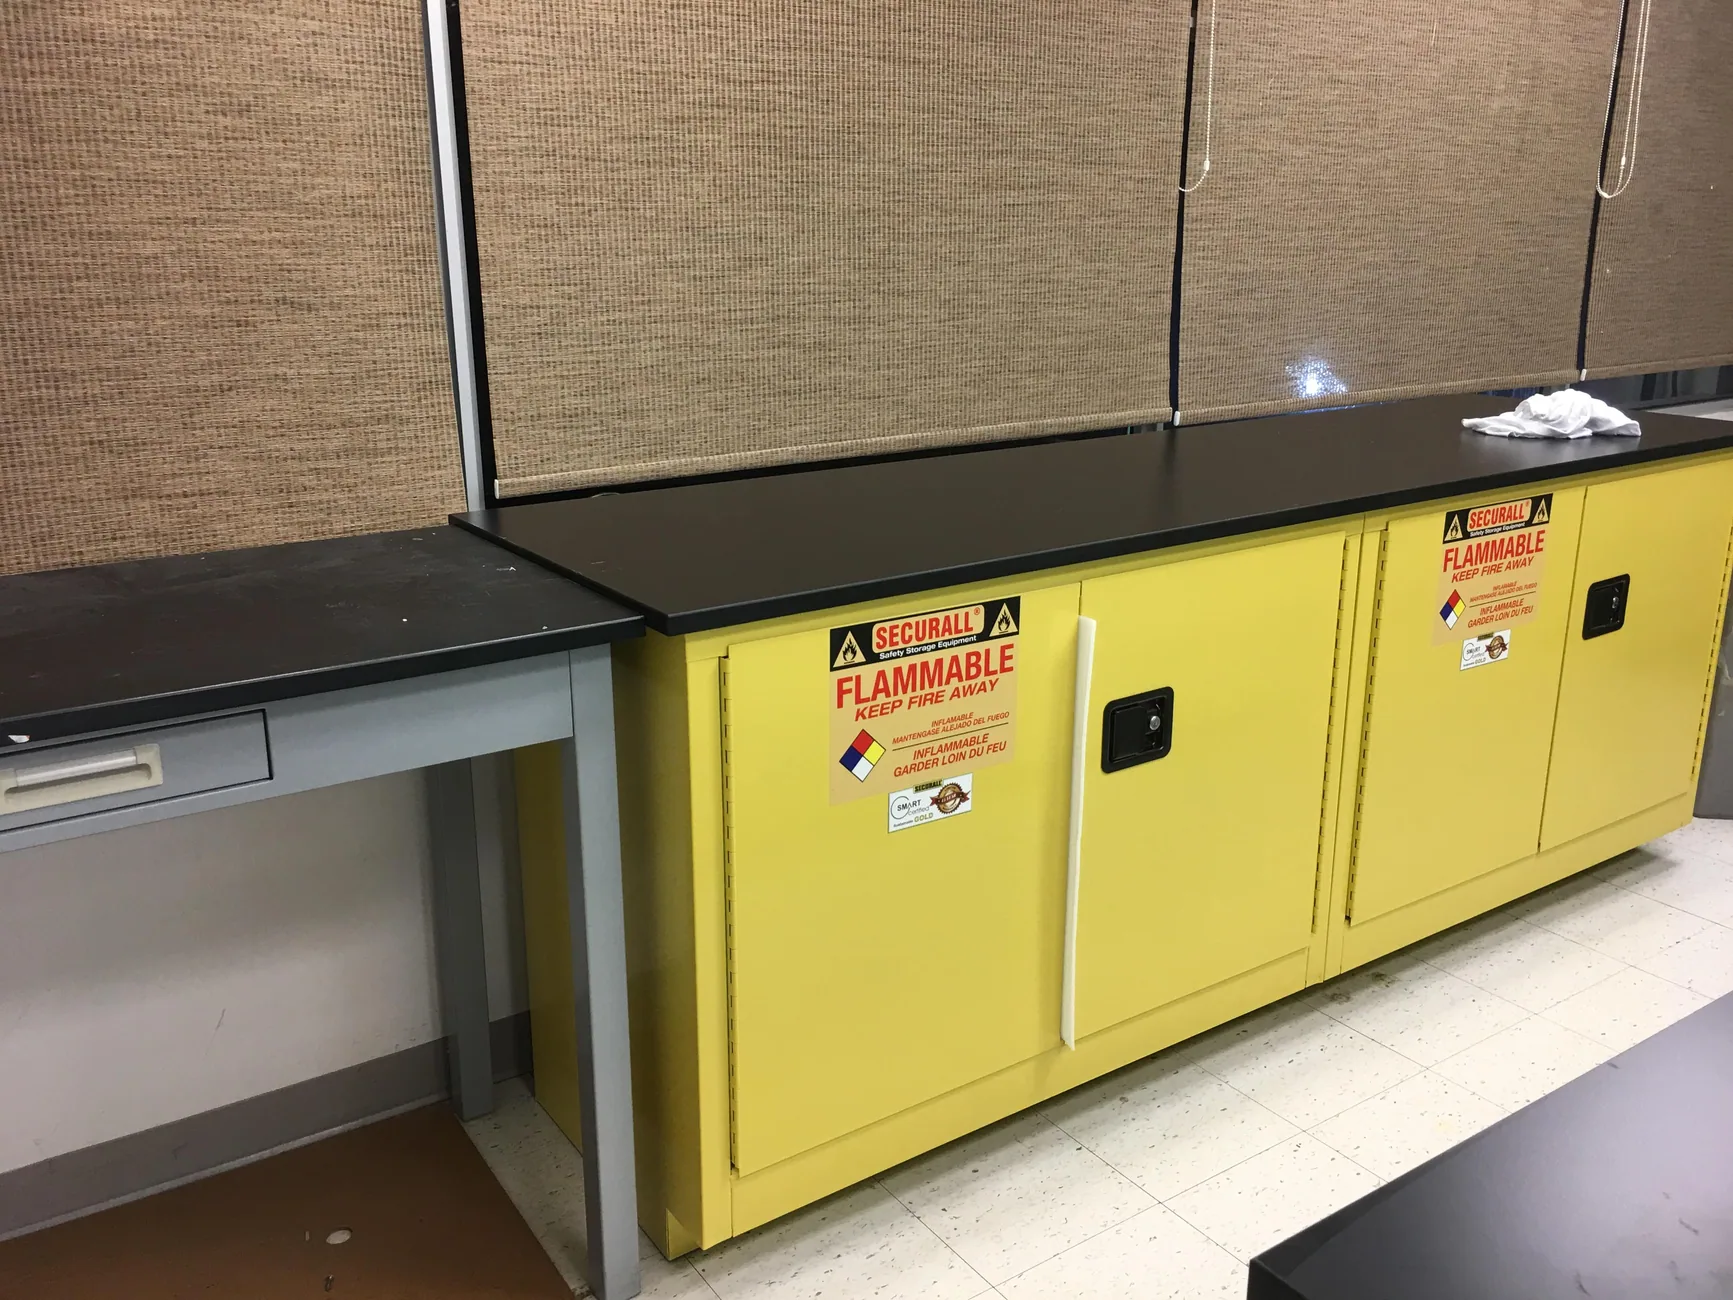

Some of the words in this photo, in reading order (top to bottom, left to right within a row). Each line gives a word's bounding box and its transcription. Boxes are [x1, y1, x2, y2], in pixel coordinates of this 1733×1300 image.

[1469, 503, 1524, 529] SECURALL
[1470, 528, 1484, 537] Safety
[1485, 526, 1502, 534] Storage
[1503, 522, 1525, 531] Equipment
[1443, 530, 1546, 572] FLAMMABLE
[1452, 568, 1479, 583] KEEP
[1481, 562, 1504, 576] FIRE
[1505, 556, 1534, 572] AWAY
[1468, 614, 1494, 628] GARDER
[1495, 610, 1511, 621] LOIN
[1511, 608, 1520, 618] DU
[1521, 605, 1534, 615] FEU
[1480, 598, 1524, 615] INFLAMMABLE
[875, 610, 973, 650] SECURALL
[879, 650, 904, 660] Safety
[906, 643, 936, 655] Storage
[938, 635, 977, 648] Equipment
[837, 644, 1014, 709] FLAMMABLE
[855, 699, 903, 722] KEEP
[908, 690, 946, 710] FIRE
[949, 678, 999, 701] AWAY
[892, 728, 940, 744] MANTENGASE
[941, 720, 972, 733] ALEJADO
[973, 717, 986, 725] DEL
[987, 711, 1010, 722] FUEGO
[931, 712, 974, 727] INFLAMABLE
[894, 757, 939, 777] GARDER
[941, 751, 966, 766] LOIN
[969, 746, 984, 758] DU
[986, 741, 1007, 754] FEU
[913, 733, 989, 760] INFLAMMABLE
[897, 799, 921, 811] SMART
[914, 812, 934, 822] GOLD
